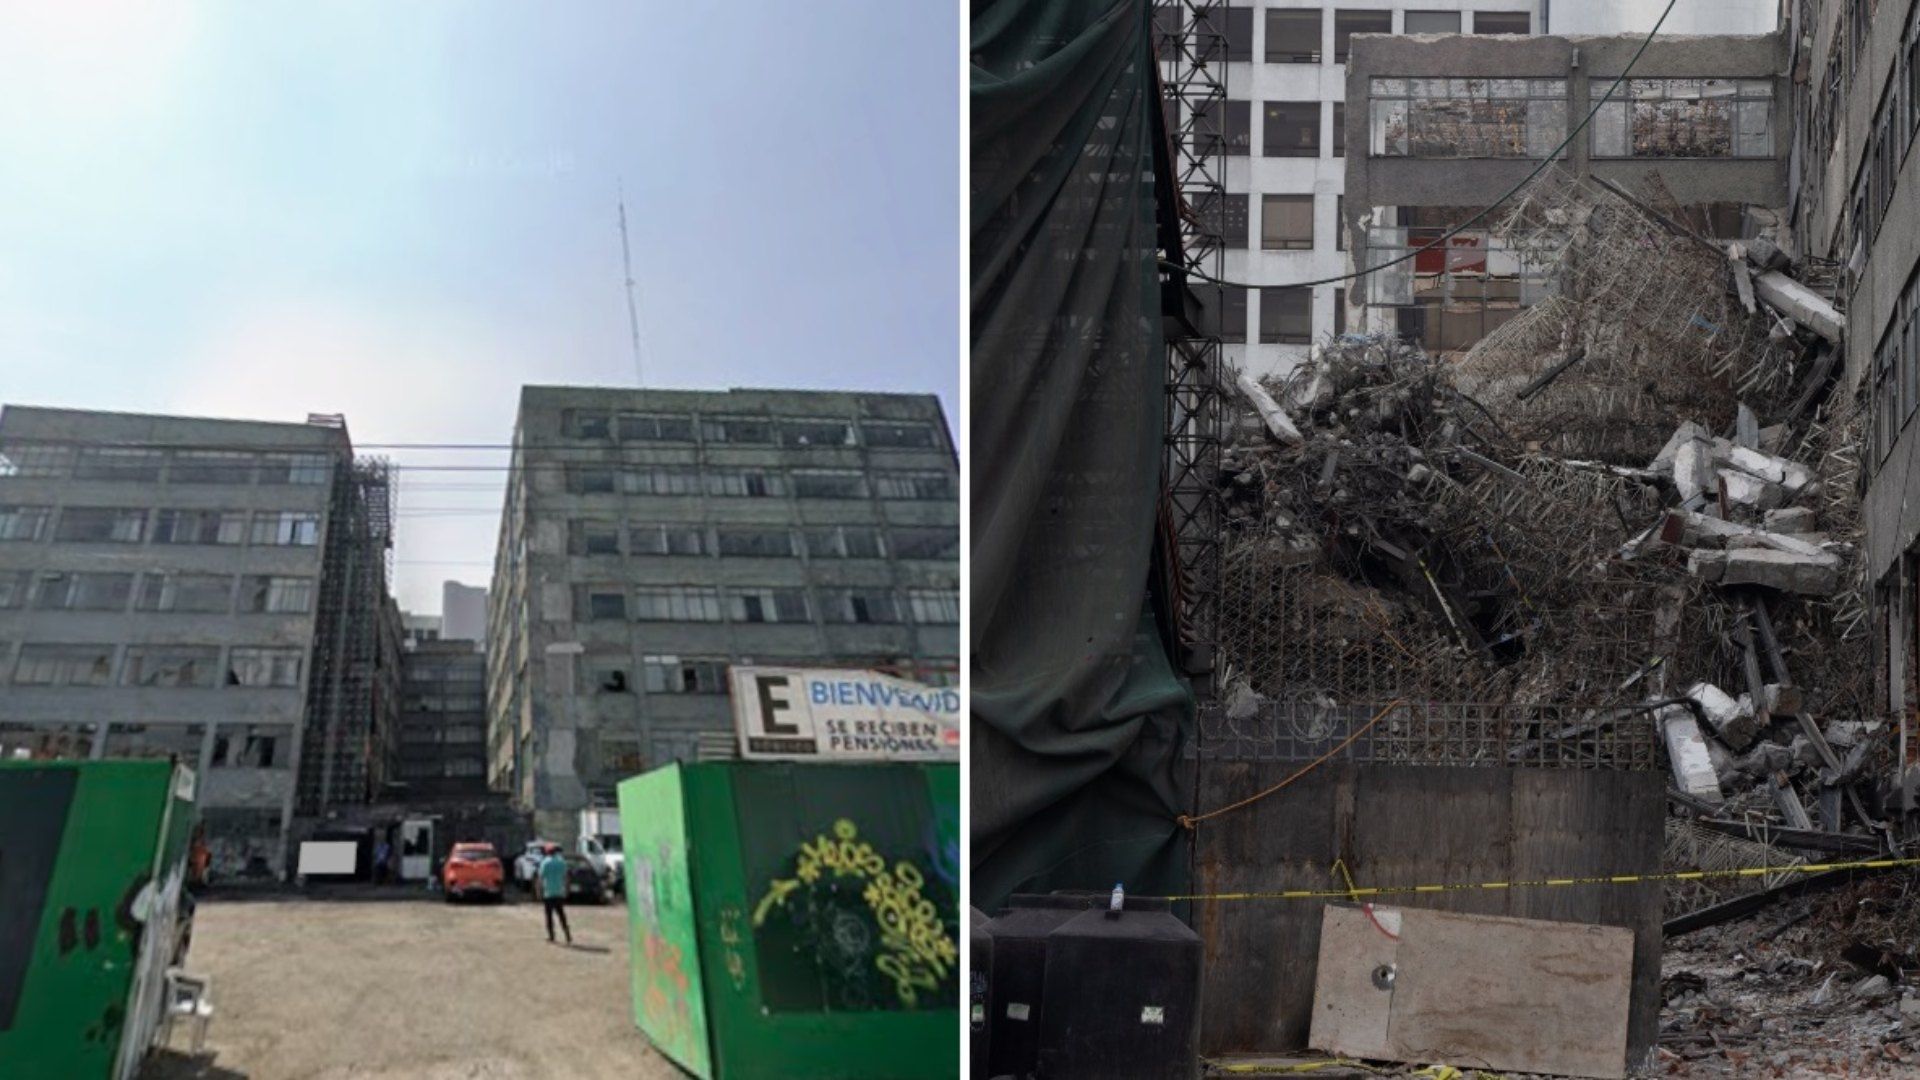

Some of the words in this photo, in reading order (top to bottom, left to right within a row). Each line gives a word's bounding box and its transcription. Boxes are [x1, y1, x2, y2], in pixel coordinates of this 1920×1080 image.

[755, 676, 799, 735] E
[826, 719, 847, 735] SE
[853, 720, 936, 736] RECIBEN
[830, 736, 940, 752] PENSIONES
